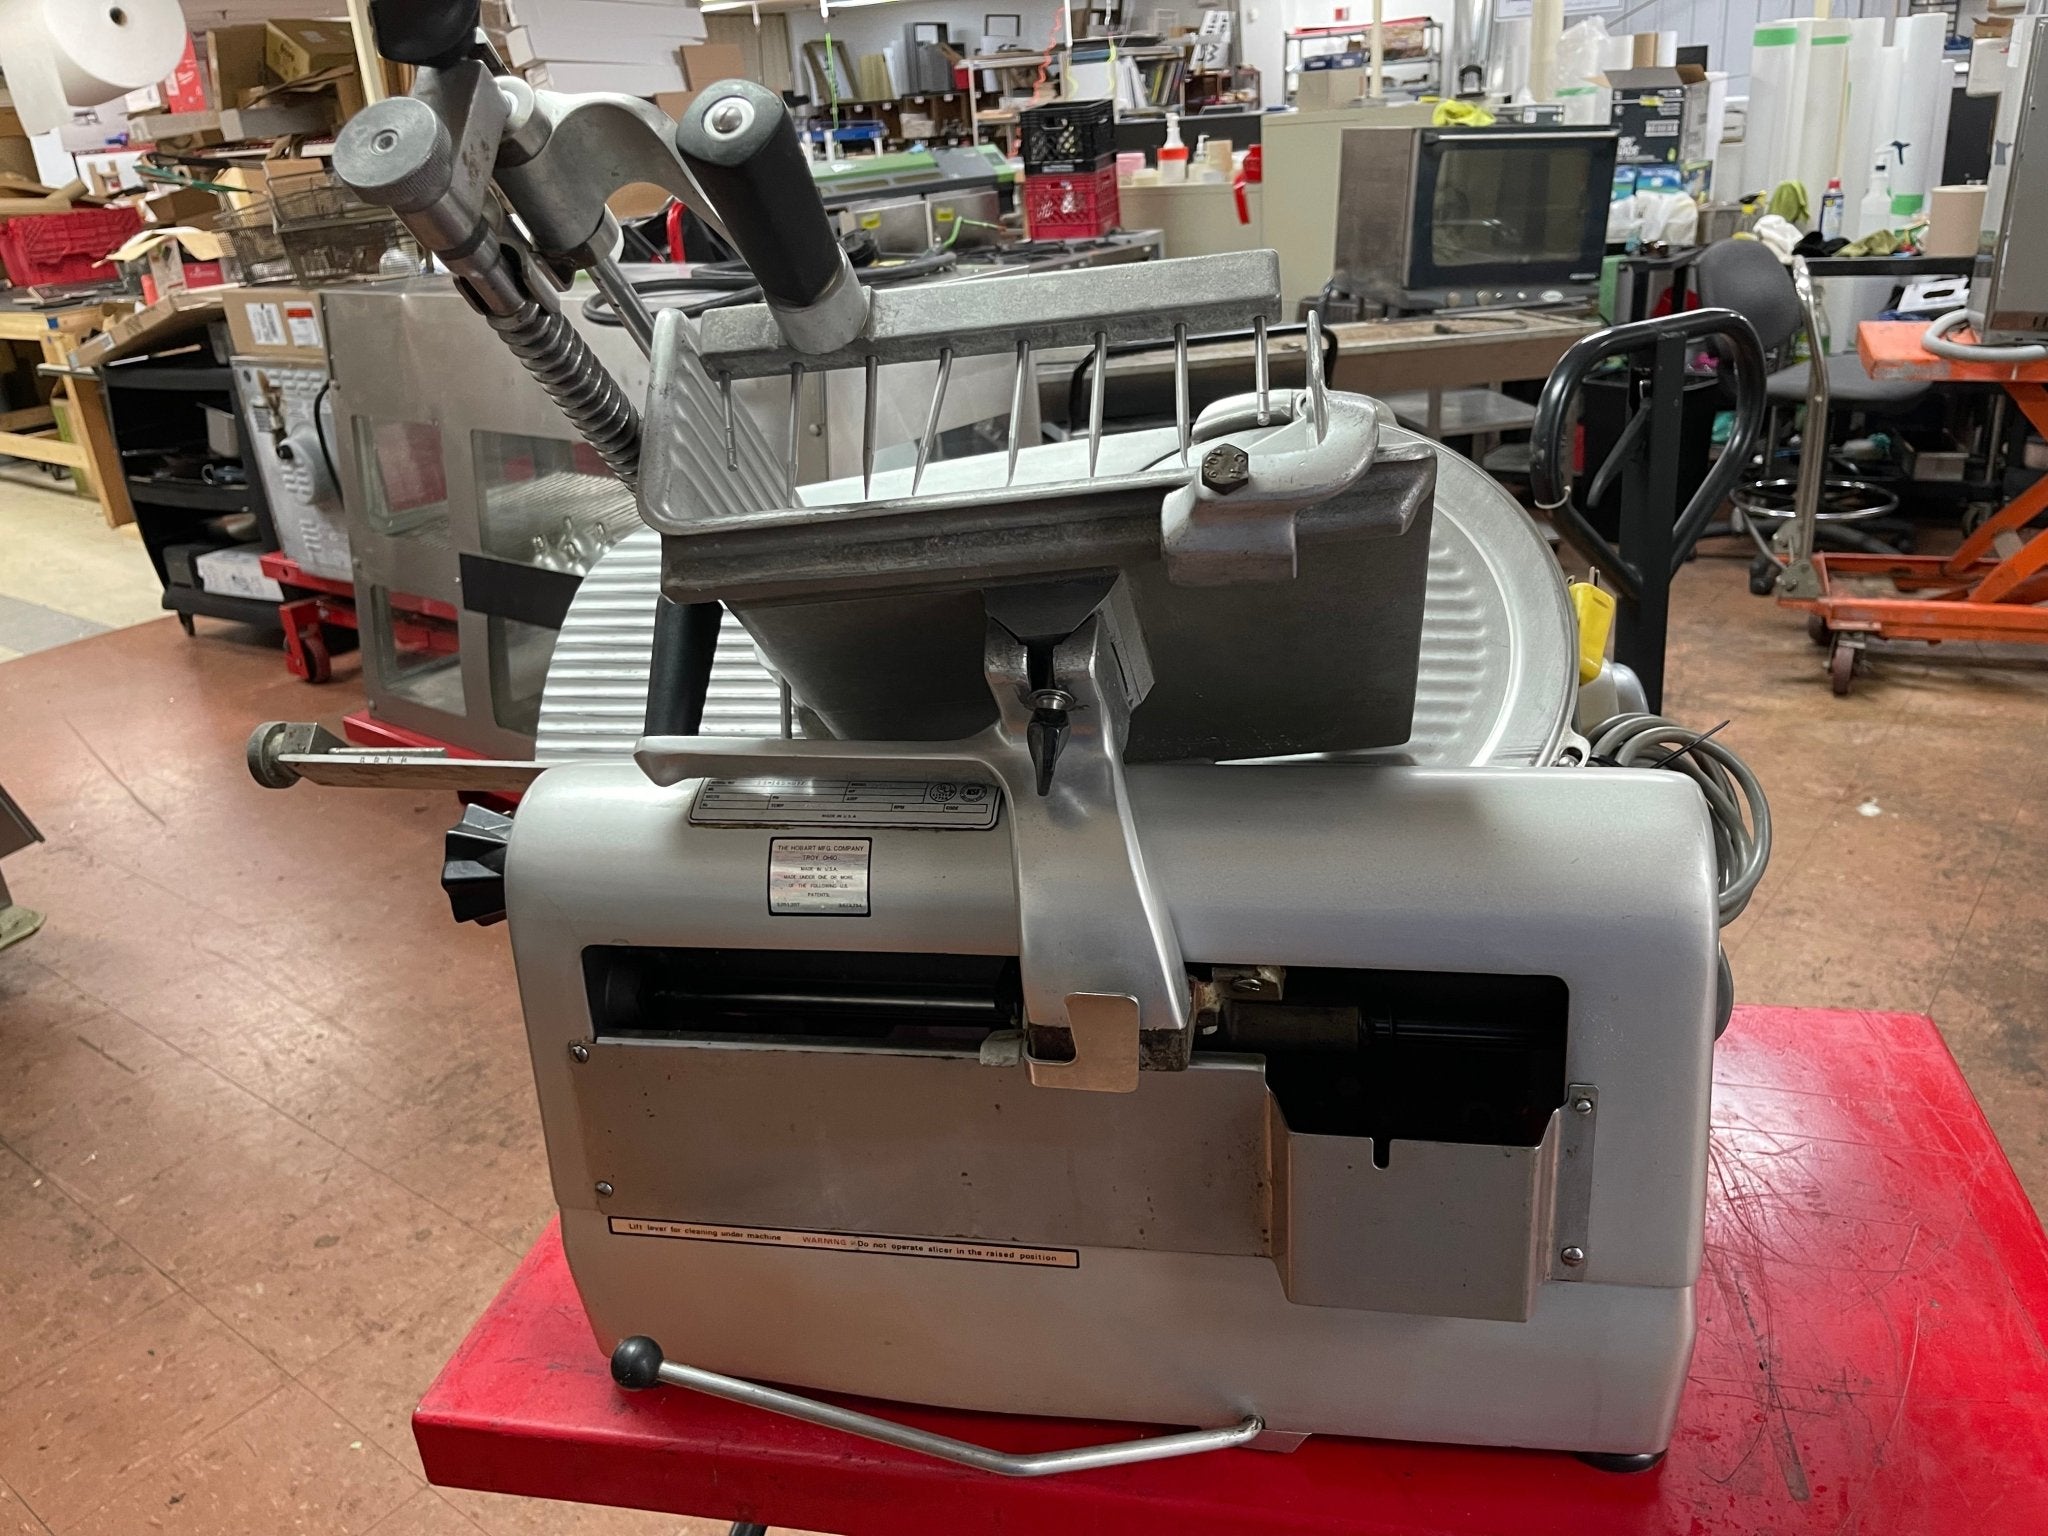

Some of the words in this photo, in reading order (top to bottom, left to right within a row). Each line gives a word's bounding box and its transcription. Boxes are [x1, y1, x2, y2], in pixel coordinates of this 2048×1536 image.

[628, 1222, 643, 1231] Lift
[647, 1224, 667, 1233] lever
[670, 1225, 681, 1234] for
[684, 1227, 718, 1238] cleaning
[721, 1230, 743, 1239] under
[747, 1232, 782, 1241] machine
[802, 1236, 848, 1246] WARNING
[857, 1240, 869, 1248] Do
[891, 1243, 924, 1253] operate
[928, 1245, 953, 1254] slicer
[956, 1247, 965, 1255] in
[967, 1248, 982, 1256] the
[985, 1249, 1015, 1259] raised
[1019, 1252, 1057, 1262] position
